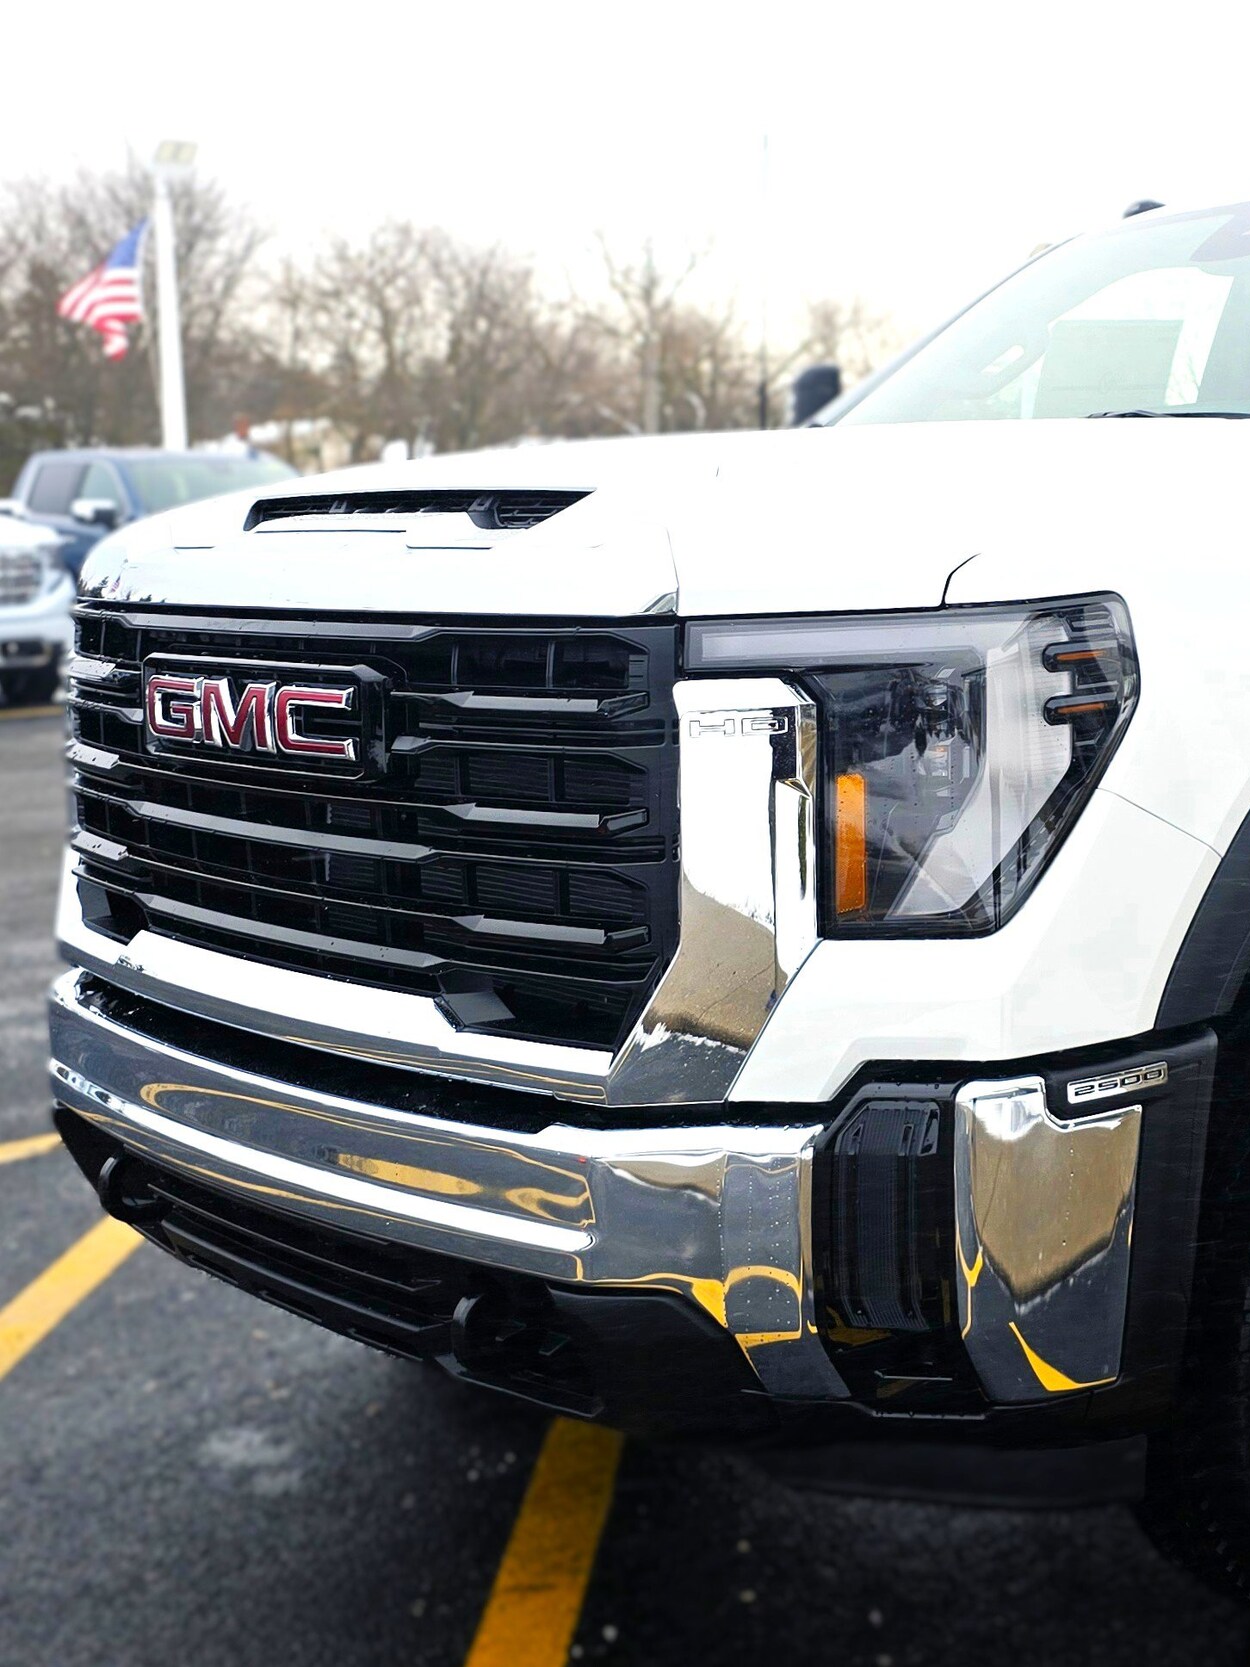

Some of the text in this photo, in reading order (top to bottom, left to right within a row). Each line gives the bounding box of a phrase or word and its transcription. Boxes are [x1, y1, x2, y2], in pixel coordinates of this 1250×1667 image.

[146, 674, 356, 761] GMC
[689, 717, 788, 738] HD
[1073, 1067, 1165, 1098] 2500
